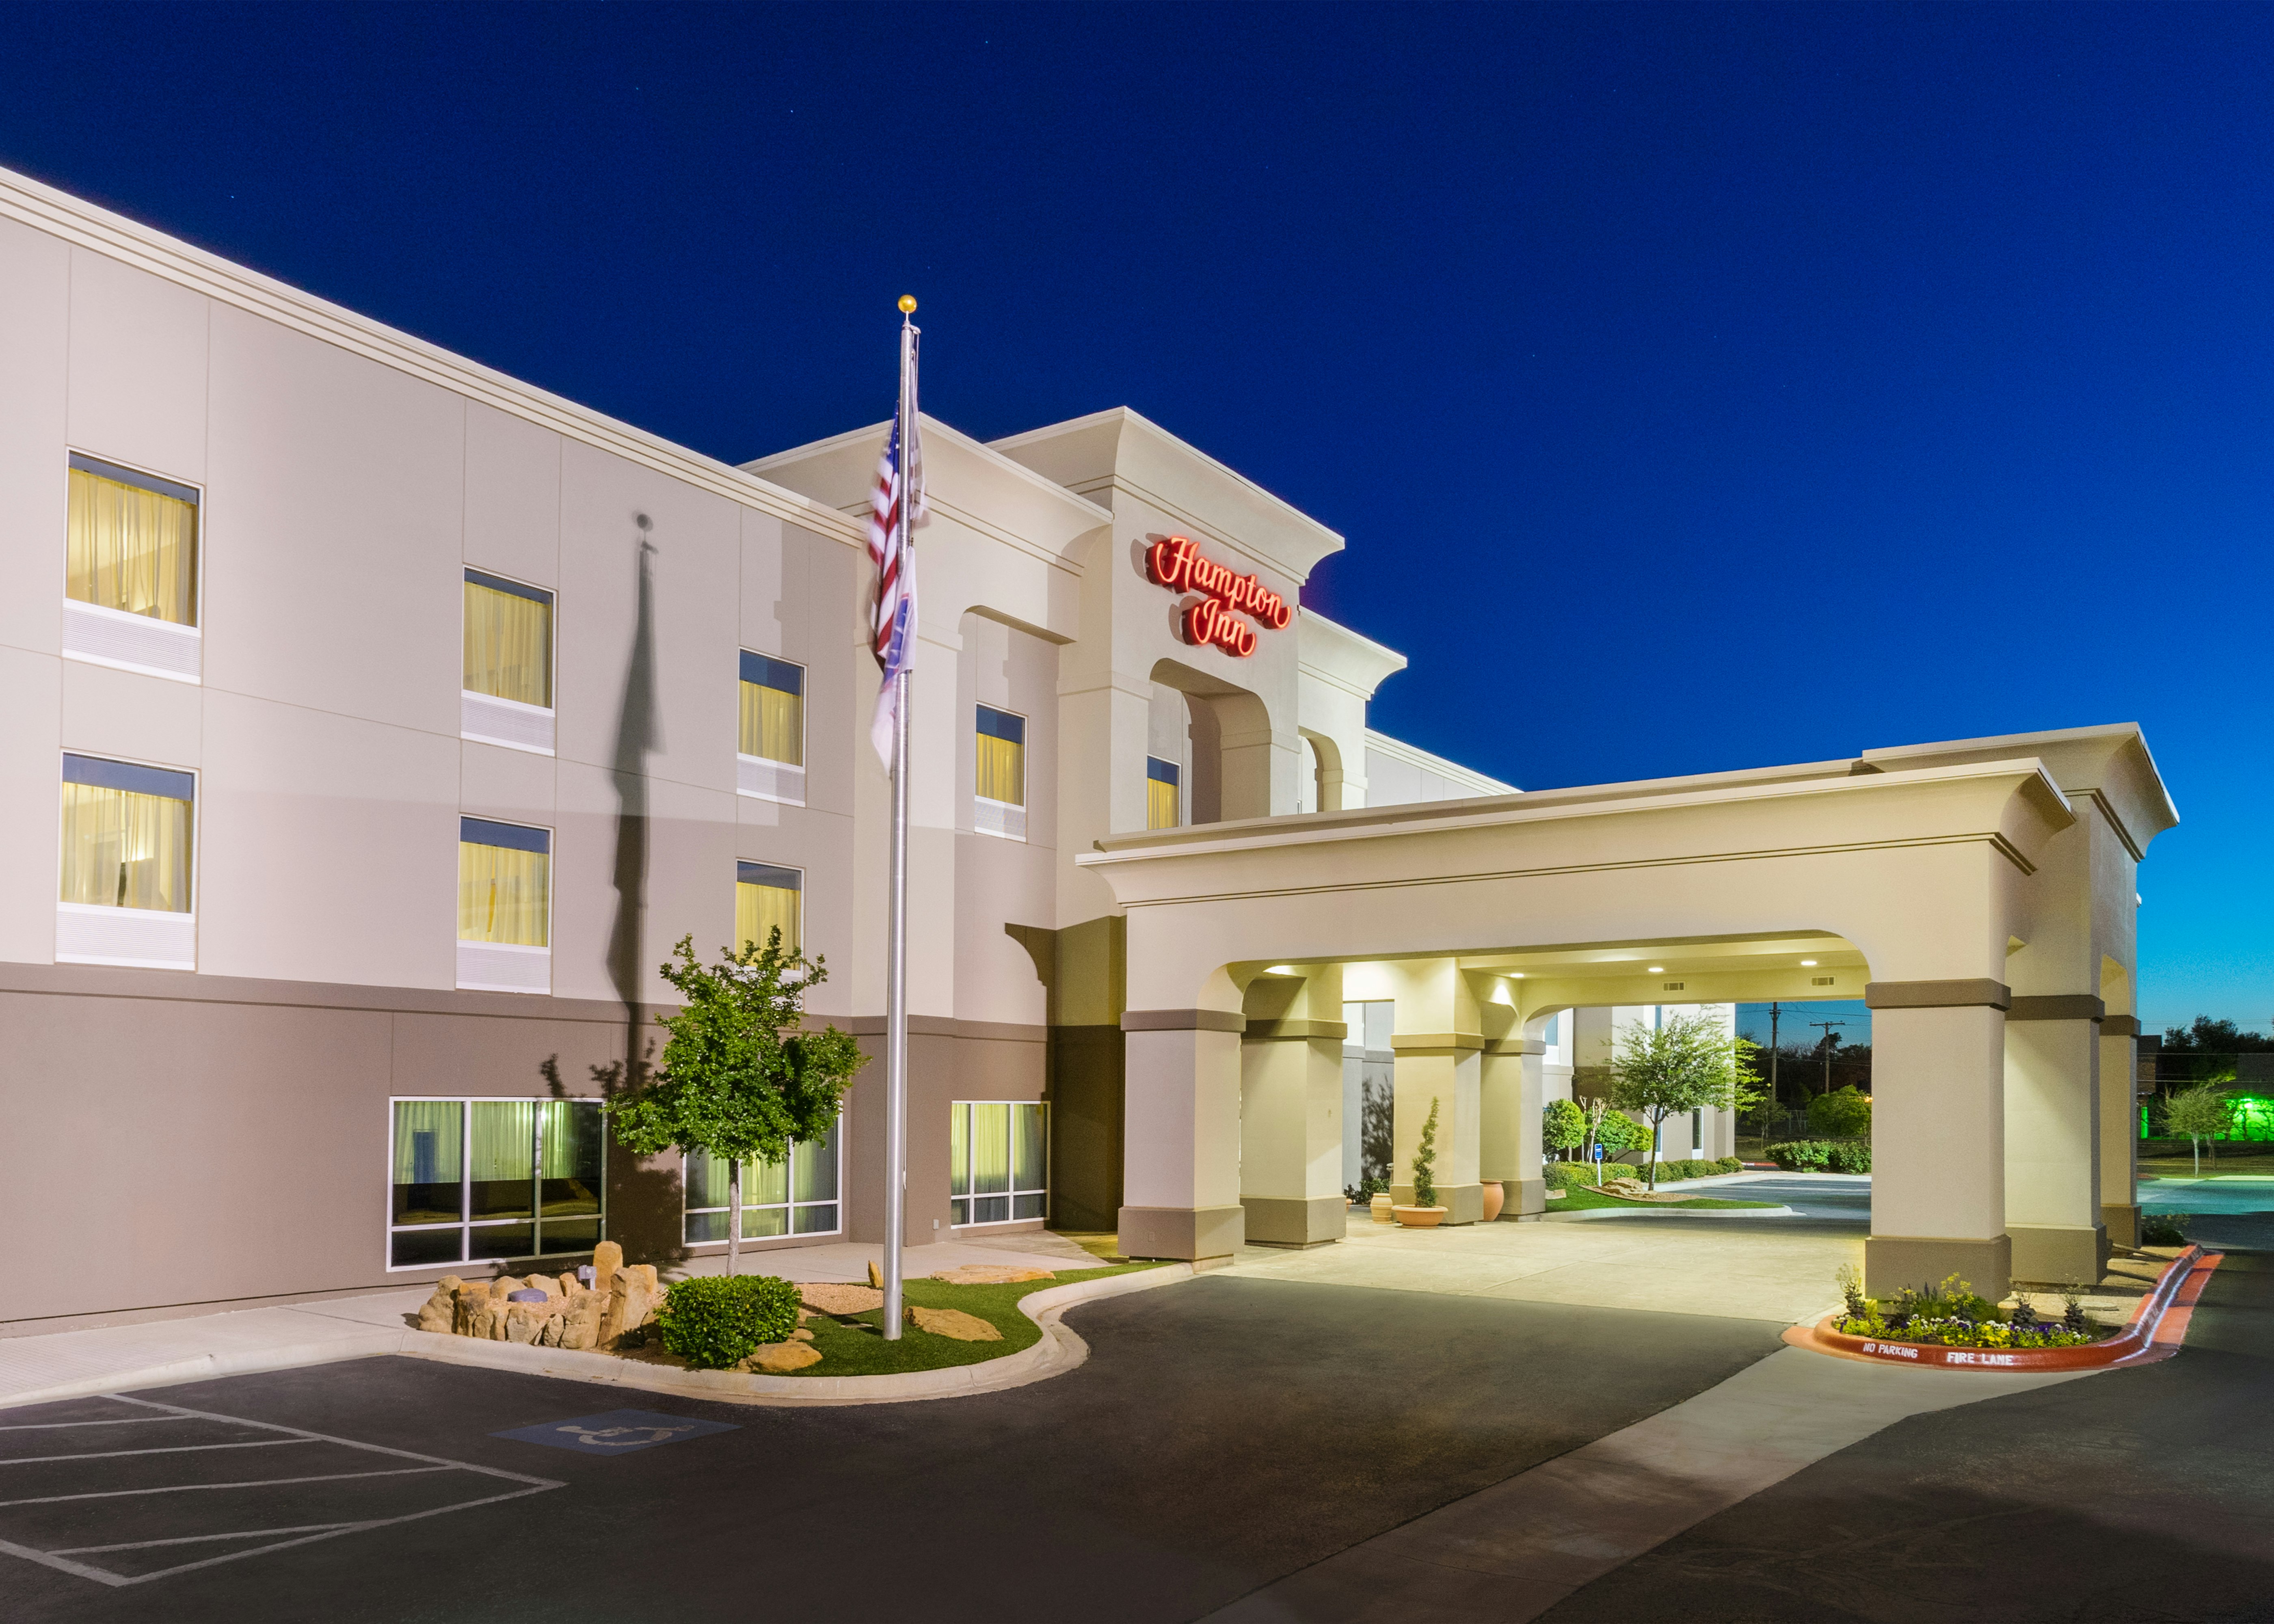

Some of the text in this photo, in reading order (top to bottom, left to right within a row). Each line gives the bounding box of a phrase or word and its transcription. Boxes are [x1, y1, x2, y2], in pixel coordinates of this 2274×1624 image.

[1155, 536, 1292, 629] Hampton
[1192, 598, 1256, 657] Inn
[1863, 1342, 1918, 1358] NO PARKING
[1947, 1351, 2015, 1366] FIRE LANE
